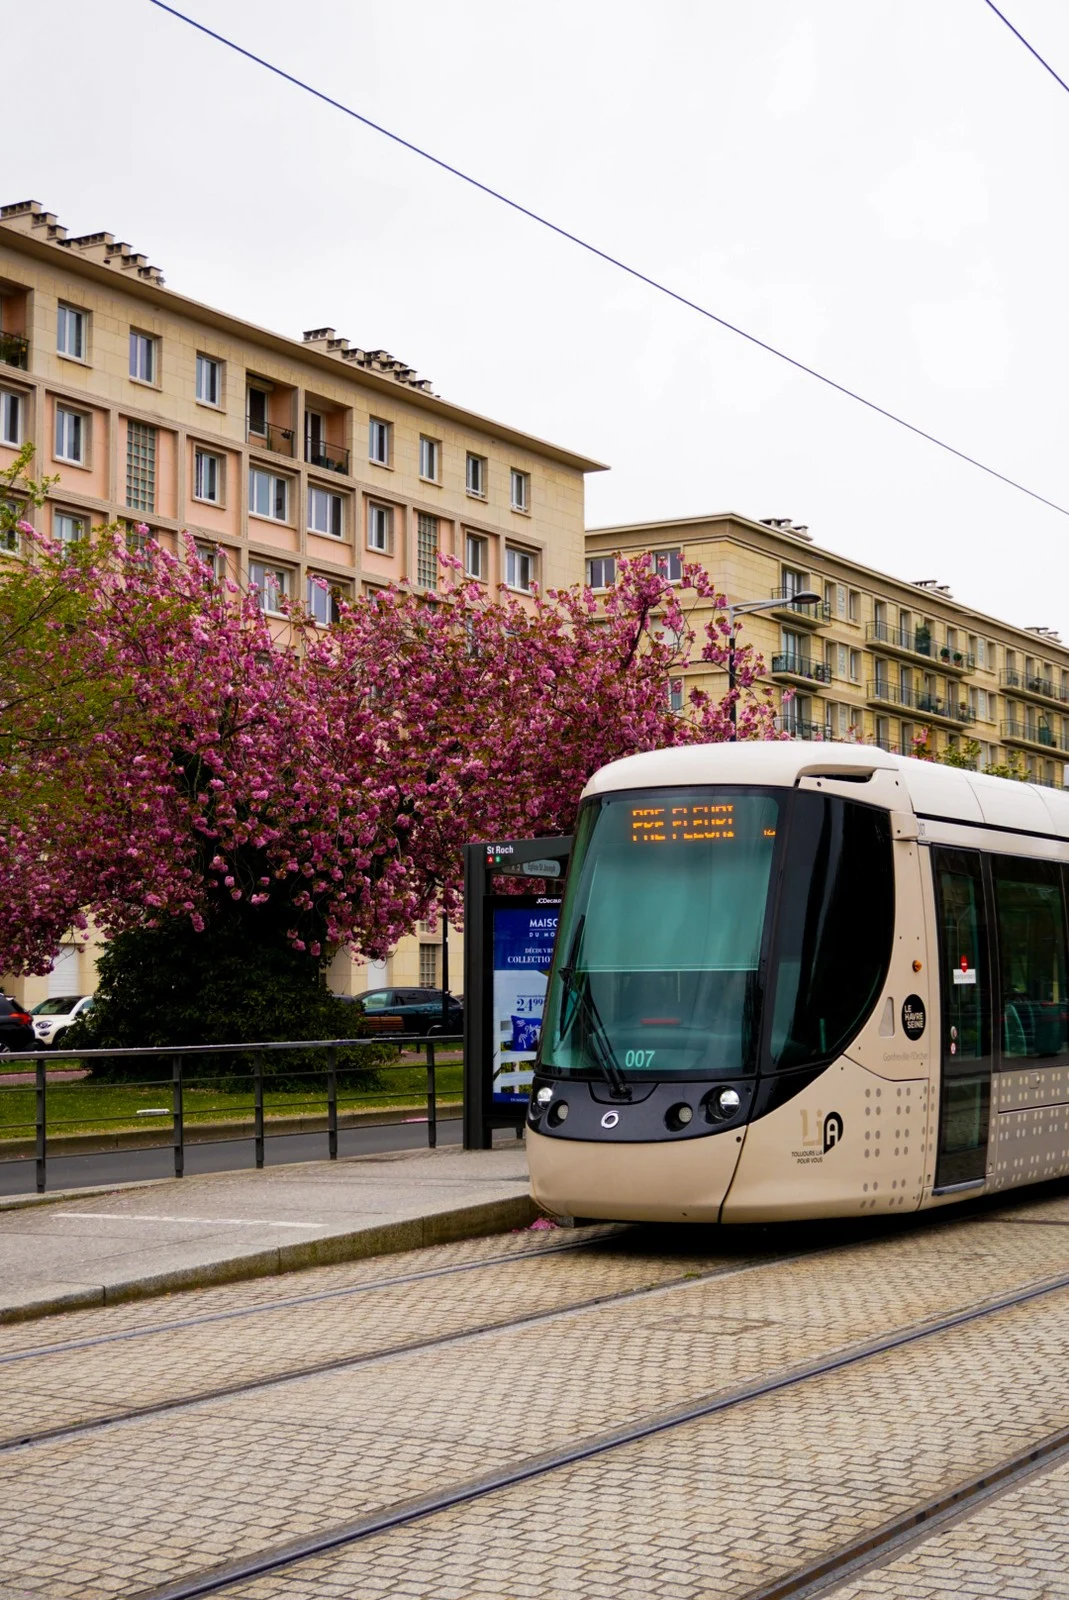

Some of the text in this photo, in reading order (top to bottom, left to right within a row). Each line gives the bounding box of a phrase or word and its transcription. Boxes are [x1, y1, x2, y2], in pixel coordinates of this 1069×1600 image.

[486, 845, 513, 854] St Roch
[904, 1004, 912, 1013] LE
[904, 1012, 924, 1021] HAVRE
[907, 1020, 924, 1029] SEINE
[625, 1049, 656, 1068] 007
[791, 1150, 815, 1158] TOUJOURS
